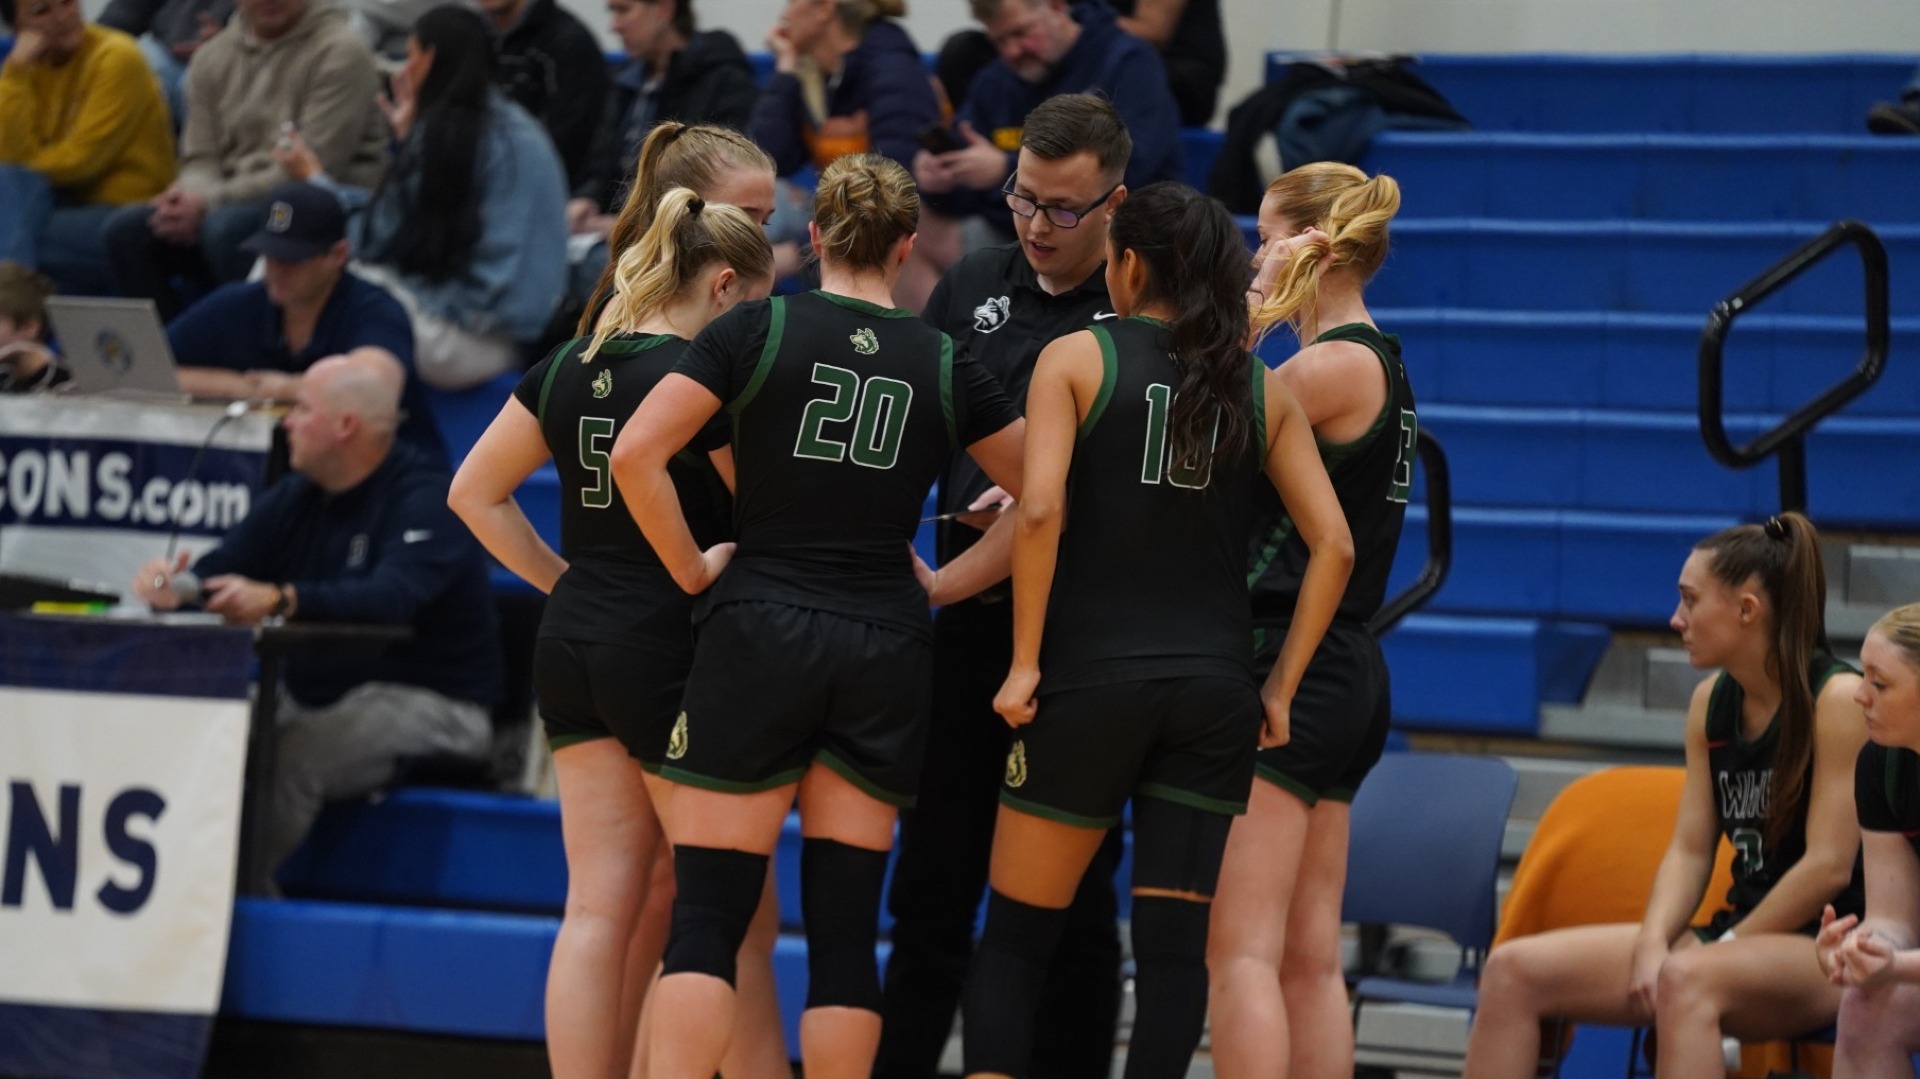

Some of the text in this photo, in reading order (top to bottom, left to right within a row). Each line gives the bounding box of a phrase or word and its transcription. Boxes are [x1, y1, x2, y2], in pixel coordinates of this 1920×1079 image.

[579, 415, 615, 509] 5
[793, 362, 914, 470] 20
[0, 448, 250, 529] ONS.com
[1, 779, 167, 918] NS
